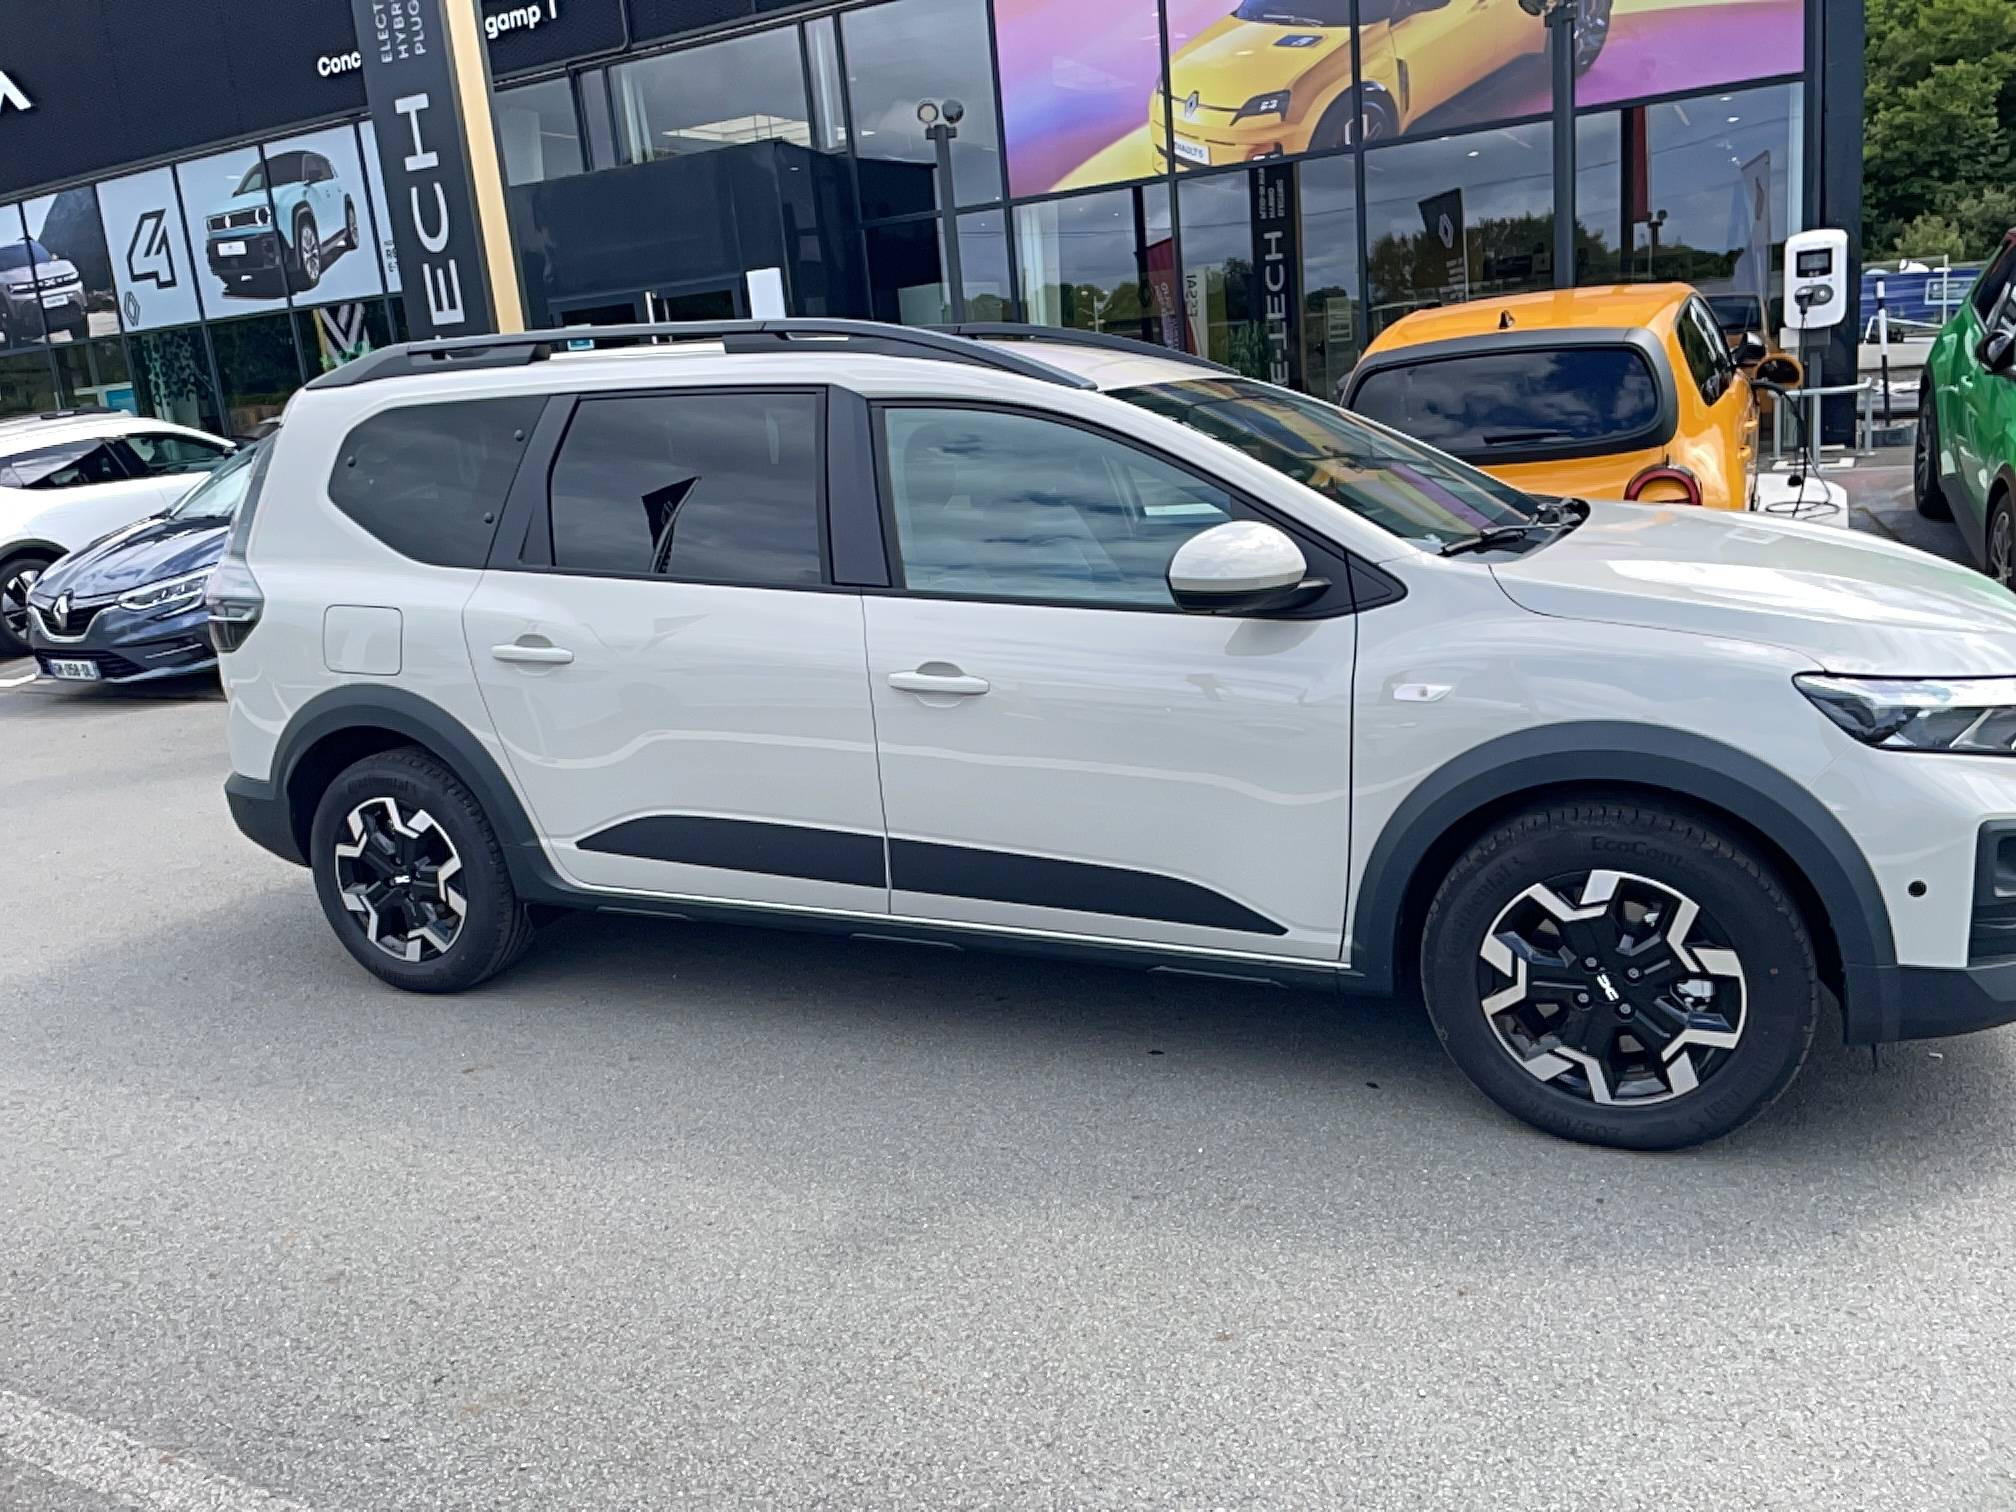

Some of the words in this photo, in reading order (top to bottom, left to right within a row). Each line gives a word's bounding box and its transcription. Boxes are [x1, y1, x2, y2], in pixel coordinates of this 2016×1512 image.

[317, 51, 361, 77] Conc
[485, 5, 541, 39] gamp
[391, 0, 409, 60] HYBR
[395, 93, 465, 326] ECH
[126, 208, 177, 289] 4
